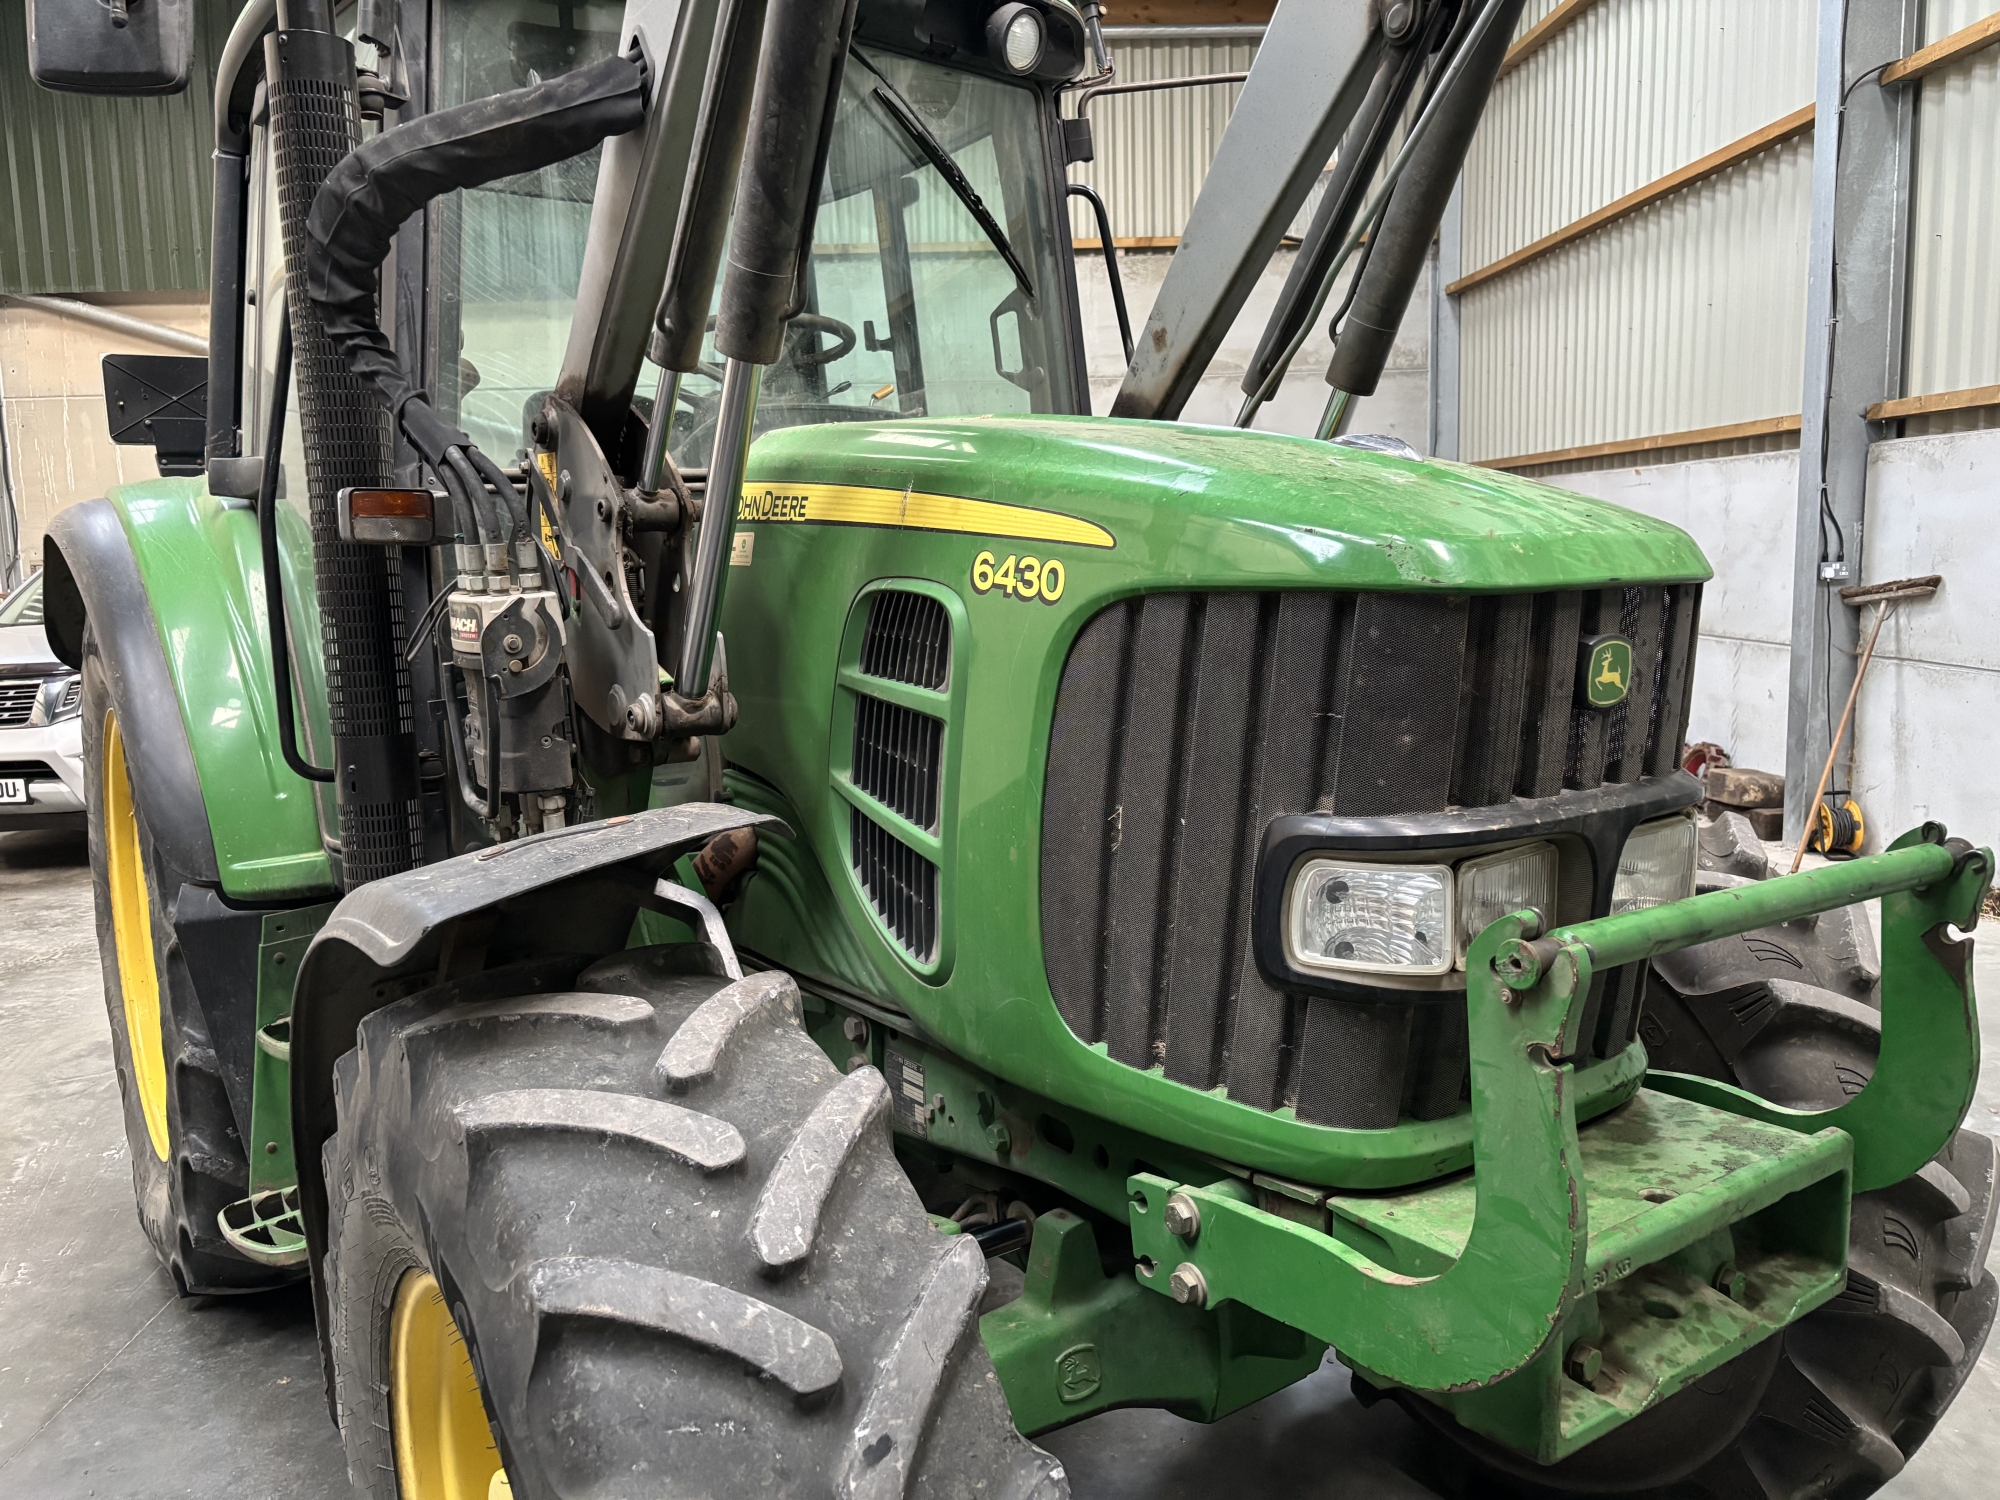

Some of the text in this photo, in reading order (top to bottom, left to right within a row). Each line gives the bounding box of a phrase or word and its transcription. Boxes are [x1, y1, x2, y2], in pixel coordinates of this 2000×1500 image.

[762, 490, 809, 518] DEERE
[970, 550, 1066, 606] 6430
[904, 1059, 918, 1071] DEERE
